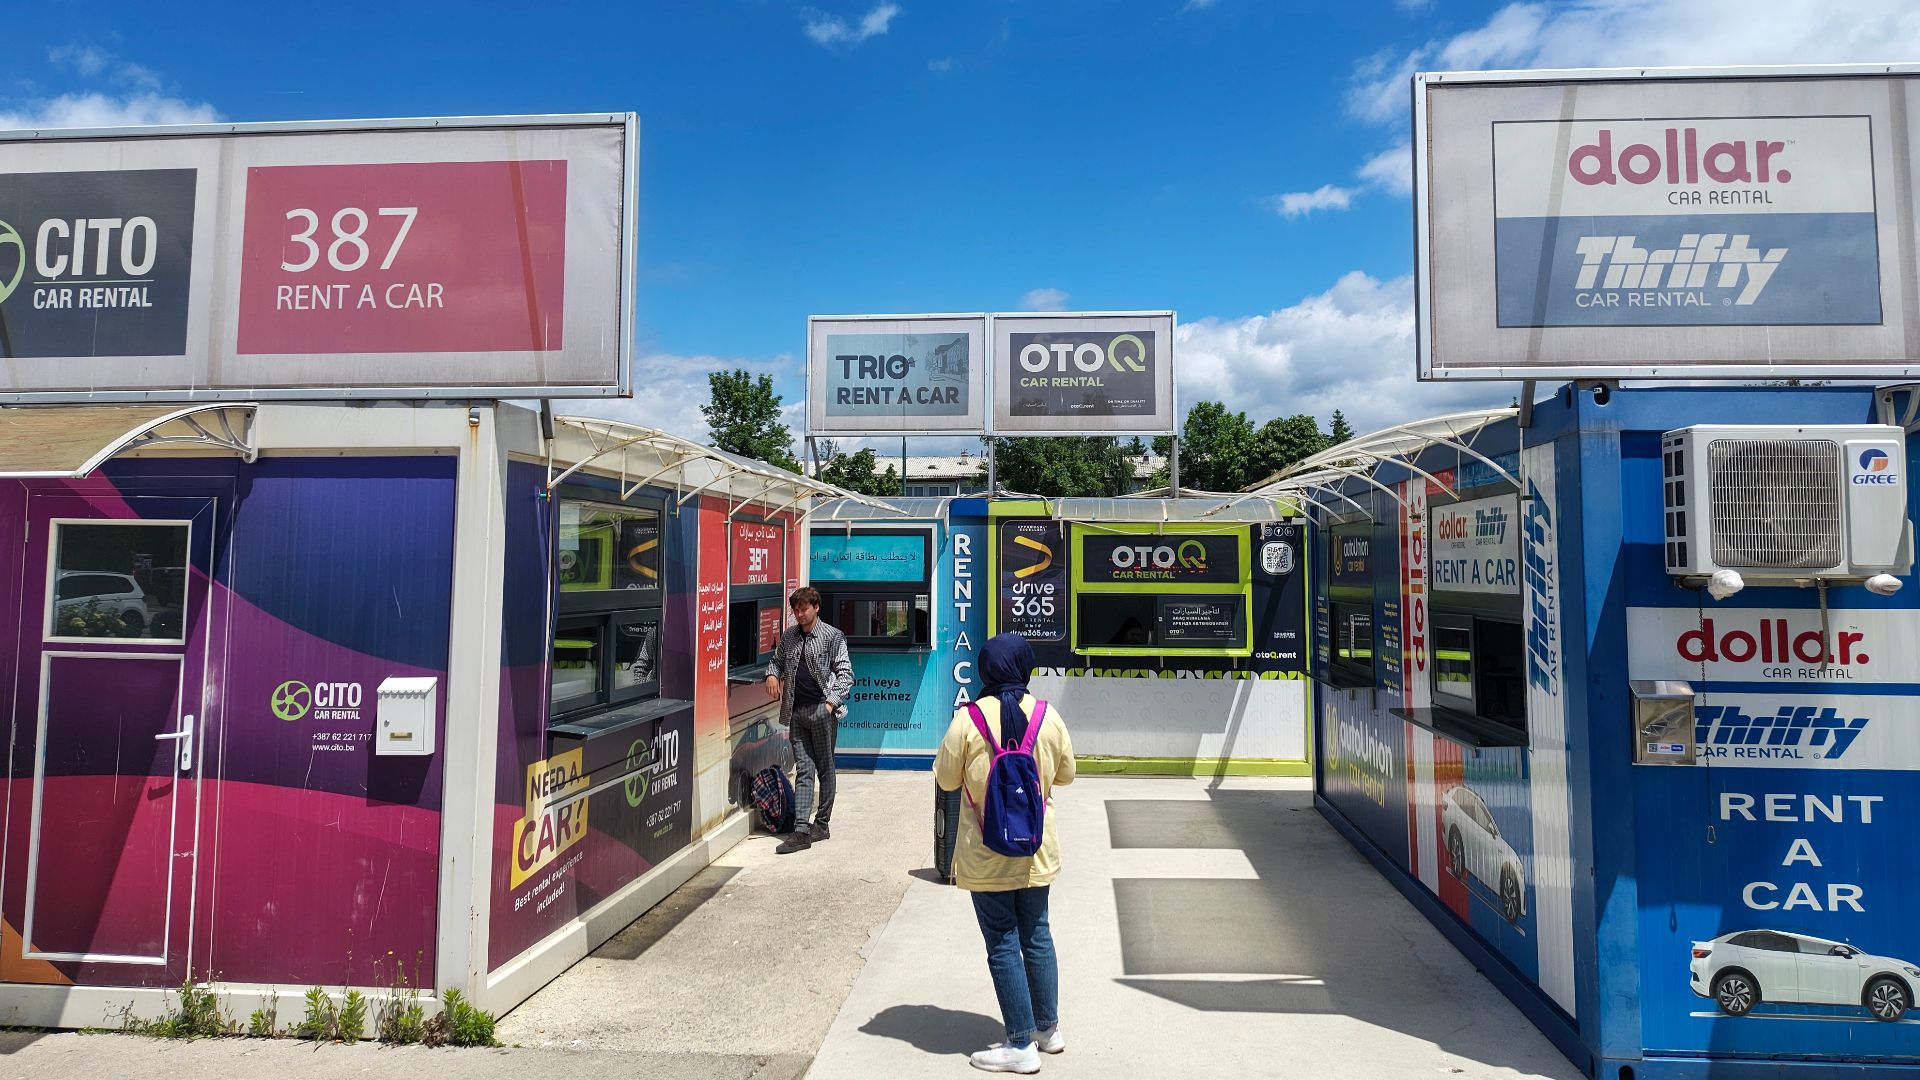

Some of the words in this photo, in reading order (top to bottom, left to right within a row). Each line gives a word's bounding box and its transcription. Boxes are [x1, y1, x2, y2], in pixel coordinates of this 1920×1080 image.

[1568, 127, 1792, 186] dollar.
[1668, 191, 1701, 206] CAR
[1709, 190, 1773, 205] RENTAL
[282, 207, 418, 273] 387
[1574, 233, 1790, 306] Thrifty
[33, 289, 72, 310] CAR
[79, 287, 152, 309] RENTAL
[277, 285, 349, 311] RENT
[357, 284, 380, 309] A
[385, 283, 444, 309] CAR
[1575, 293, 1620, 308] CAR
[1628, 292, 1711, 307] RENTAL
[835, 354, 910, 380] TRIO
[836, 387, 894, 405] RENT
[897, 386, 912, 404] A
[916, 386, 959, 404] CAR
[1020, 377, 1048, 388] CAR
[1052, 377, 1104, 387] RENTAL
[1853, 474, 1898, 485] GREE
[1439, 511, 1468, 540] dollar.
[1476, 507, 1508, 545] Thrifty
[748, 547, 768, 570] 387
[954, 534, 972, 622] RENT
[1112, 571, 1134, 579] CAR
[1136, 571, 1176, 579] RENTAL
[1435, 559, 1467, 584] RENT
[1472, 559, 1481, 585] A
[1485, 559, 1517, 586] CAR
[1012, 581, 1055, 595] drive
[1523, 476, 1552, 697] Thrifty
[1011, 597, 1055, 616] 365
[1546, 559, 1557, 642] RENTAL
[954, 631, 972, 651] A
[1676, 618, 1870, 666] dollar.
[1255, 651, 1297, 659] otoQ.rent
[874, 679, 900, 689] veya
[1550, 650, 1558, 697] CAR
[1763, 668, 1792, 679] CAR
[1798, 669, 1853, 679] RENTAL
[314, 682, 362, 707] CITO
[854, 690, 911, 703] gerekmez
[953, 661, 972, 719] CA
[314, 710, 330, 720] CAR
[331, 710, 361, 720] RENTAL
[890, 721, 922, 730] required
[312, 733, 330, 741] +387
[332, 733, 341, 741] 62
[342, 733, 357, 741] 221
[359, 733, 373, 741] 717
[1695, 706, 1870, 759] Thrifty
[312, 743, 355, 752] www.cito.ba
[1340, 716, 1394, 780] autoUnion
[1735, 748, 1804, 759] RENTAL
[530, 765, 566, 802] NEED
[570, 760, 580, 786] A
[651, 778, 662, 796] CAR
[662, 772, 678, 792] RENTAL
[1349, 763, 1360, 790] car
[1361, 771, 1385, 809] rental
[1719, 792, 1884, 824] RENT
[517, 798, 585, 872] CAR?
[1781, 838, 1823, 867] A
[514, 890, 531, 912] Best
[531, 873, 551, 898] rental
[552, 850, 584, 881] experience
[536, 882, 565, 914] included!
[1742, 881, 1866, 913] CAR
